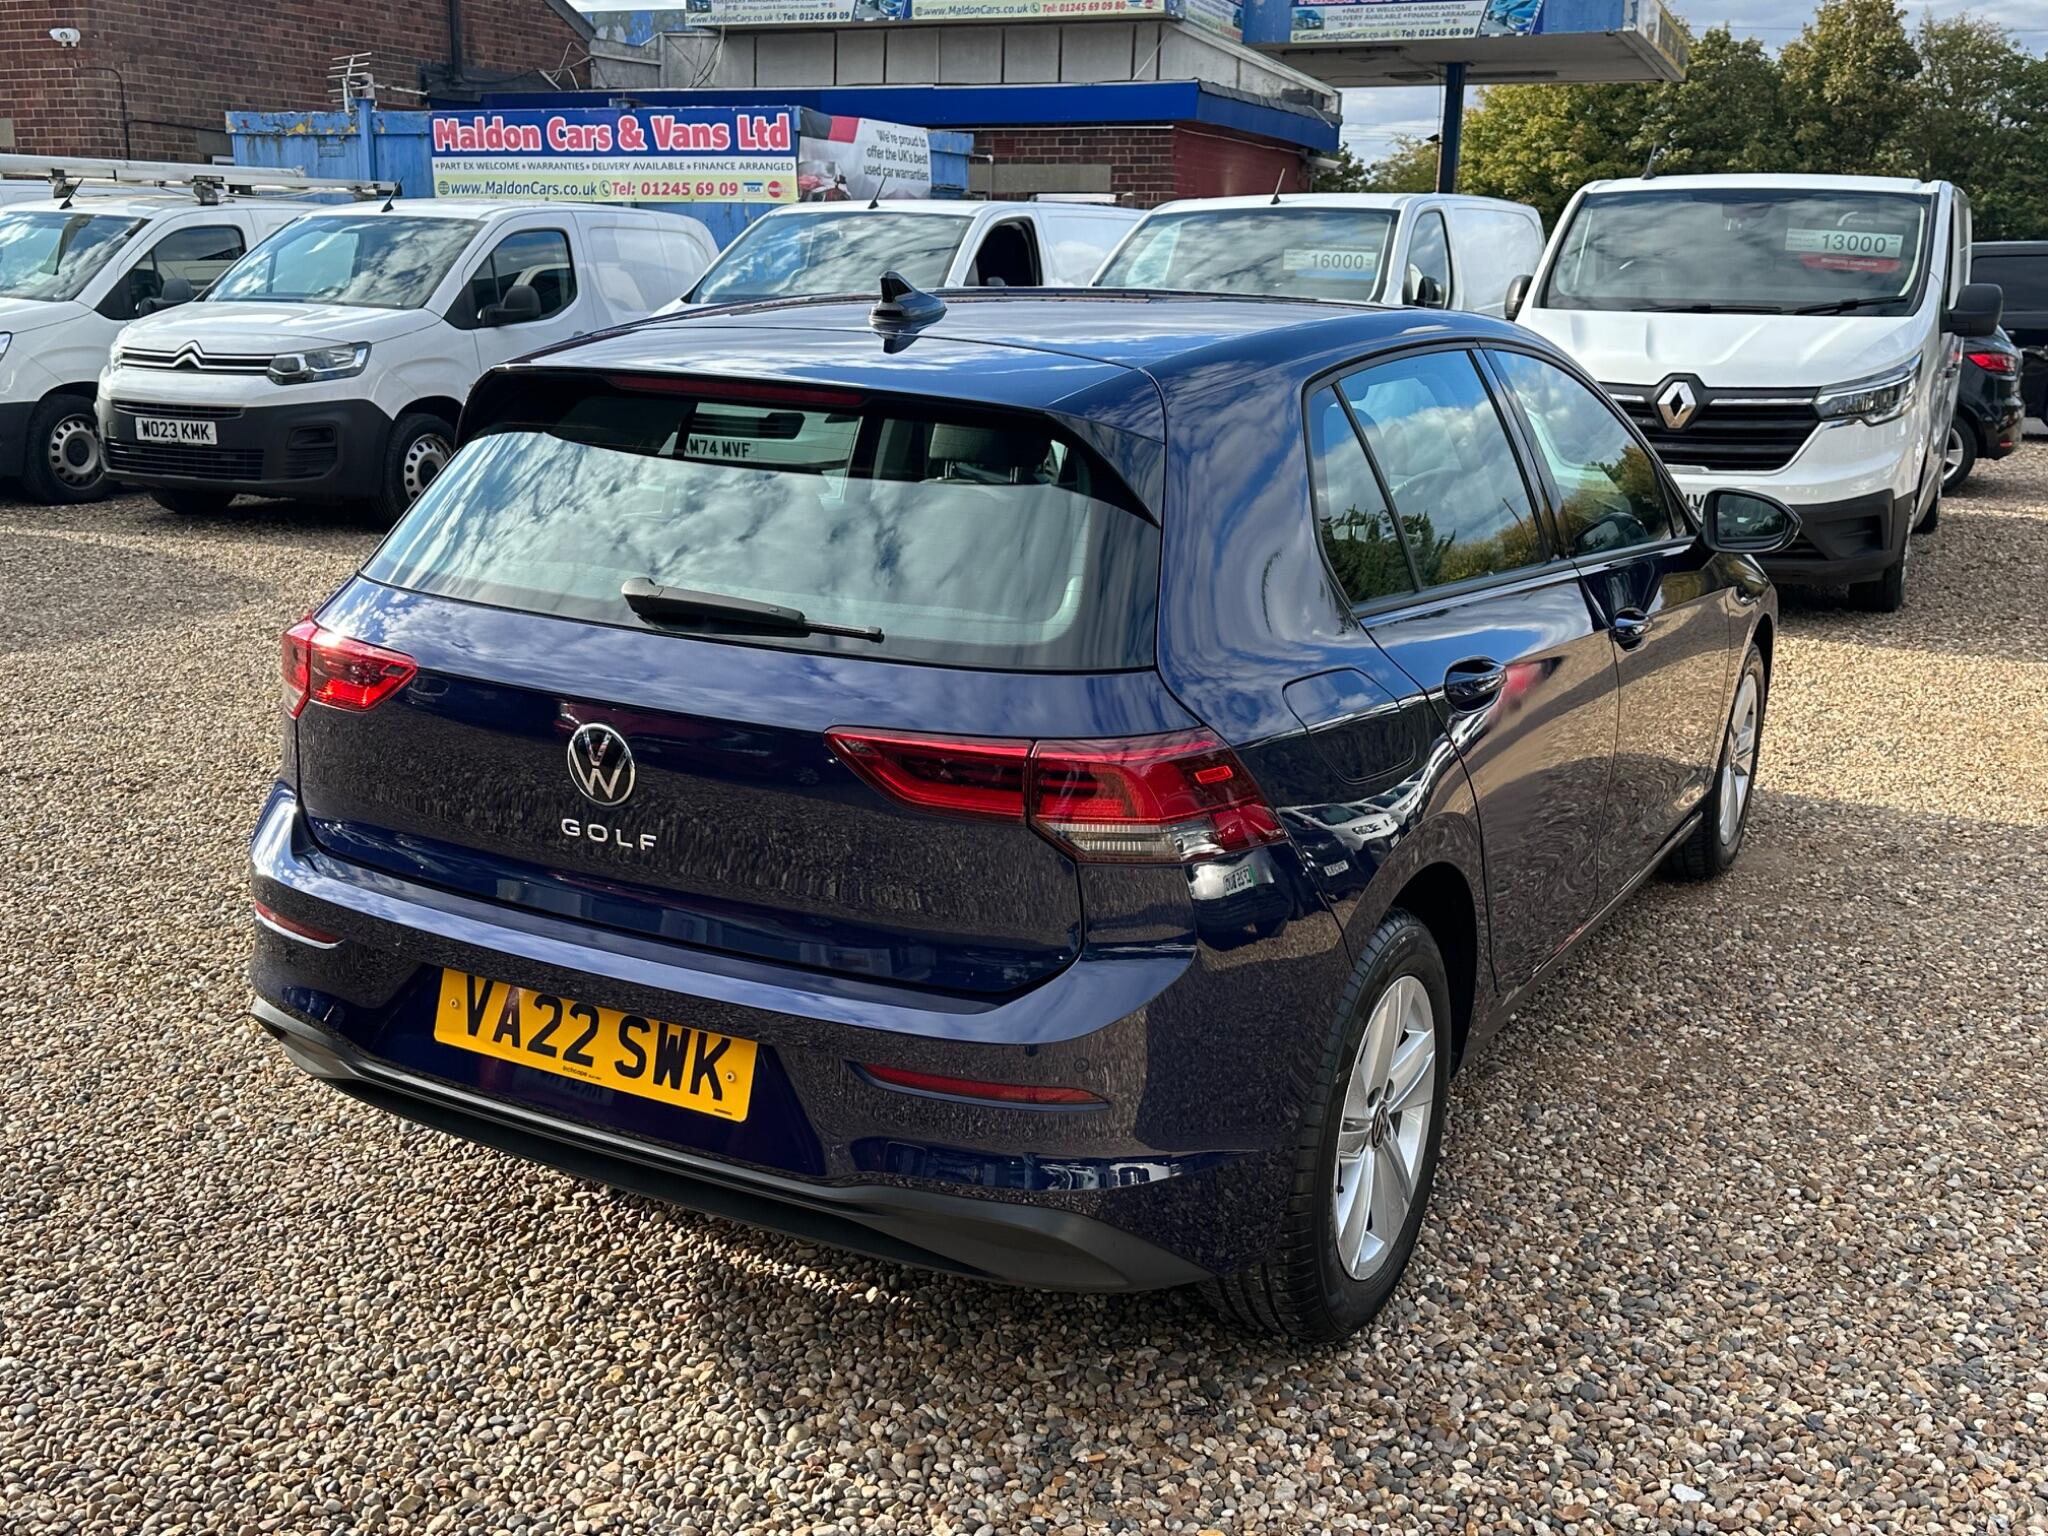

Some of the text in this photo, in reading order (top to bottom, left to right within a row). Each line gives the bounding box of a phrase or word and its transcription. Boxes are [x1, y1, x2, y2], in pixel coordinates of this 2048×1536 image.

[799, 11, 825, 20] 01245
[827, 11, 838, 20] 69
[840, 11, 850, 20] 09
[924, 5, 1029, 16] www.MaldonCars.co.uk
[1060, 2, 1086, 12] 01245
[1089, 2, 1100, 11] 69
[1419, 28, 1447, 37] 01245
[1449, 28, 1461, 36] 69
[1463, 27, 1474, 36] 09
[433, 113, 791, 152] Maldon Cars & Vans Ltd
[899, 135, 919, 148] proud
[866, 145, 884, 159] offer
[885, 148, 897, 161] the
[440, 161, 794, 171] PART EX WELCOME WARRANTIES DELIVERY AVAILABLE FINANCE ARRANGED
[864, 164, 882, 176] used
[451, 181, 598, 196] www.MaldonCars.co.uk
[612, 182, 637, 196] Tel:
[641, 182, 691, 196] 01245
[696, 182, 715, 196] 69
[719, 182, 738, 196] 09
[1822, 234, 1887, 253] 13000
[1311, 254, 1364, 269] 16000
[142, 419, 211, 441] WO23 KMK
[686, 440, 750, 458] M74 MVF
[561, 819, 657, 851] GOLF
[466, 974, 732, 1102] VA22 SWK
